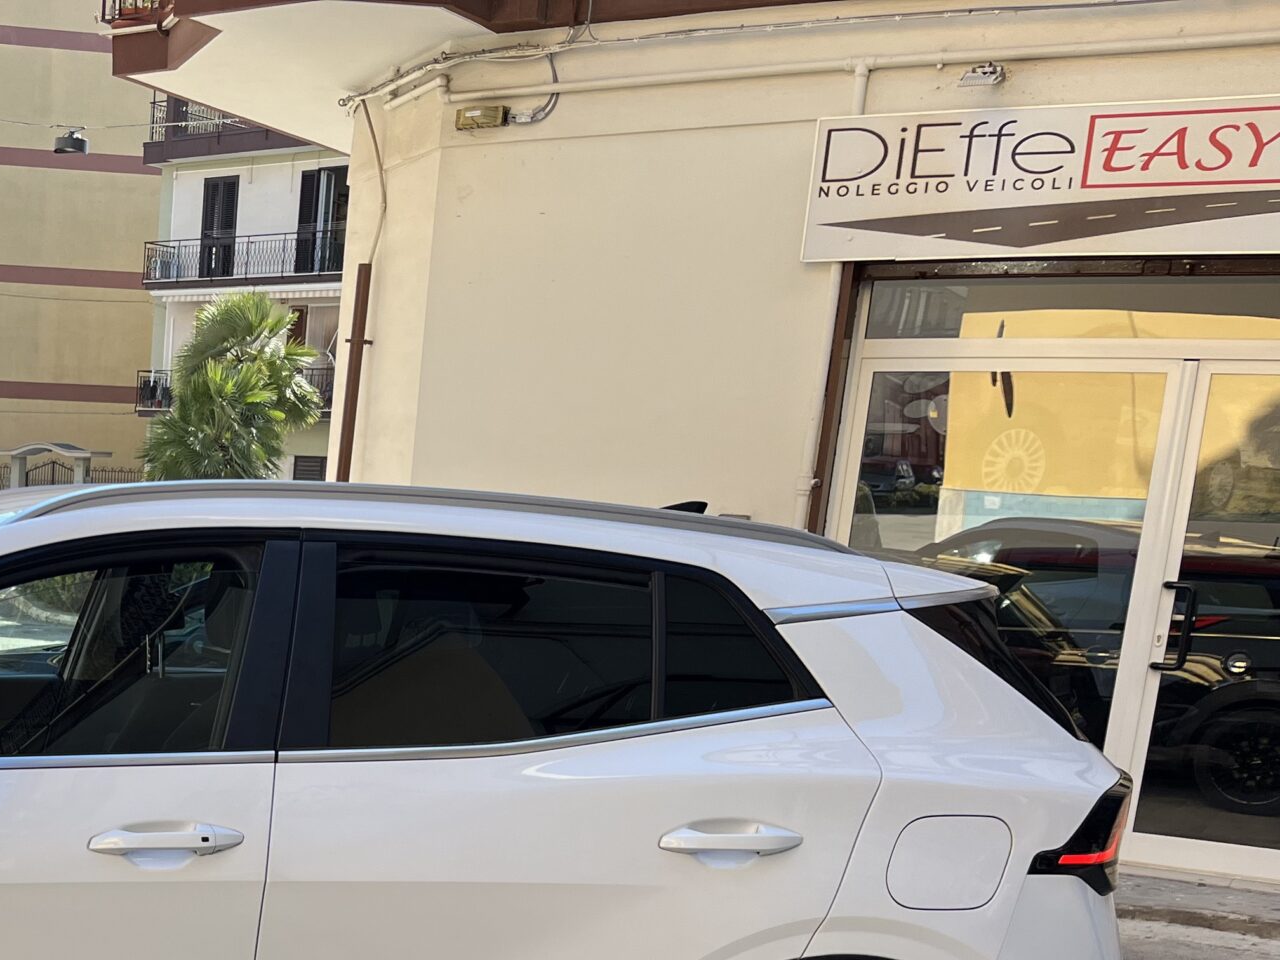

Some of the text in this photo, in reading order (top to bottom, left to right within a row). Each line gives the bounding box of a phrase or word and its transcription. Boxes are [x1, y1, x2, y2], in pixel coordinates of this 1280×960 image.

[821, 120, 1076, 183] DiEffe
[1101, 121, 1280, 172] EASY
[818, 177, 1073, 198] NOLEGGIO VEICOLI
